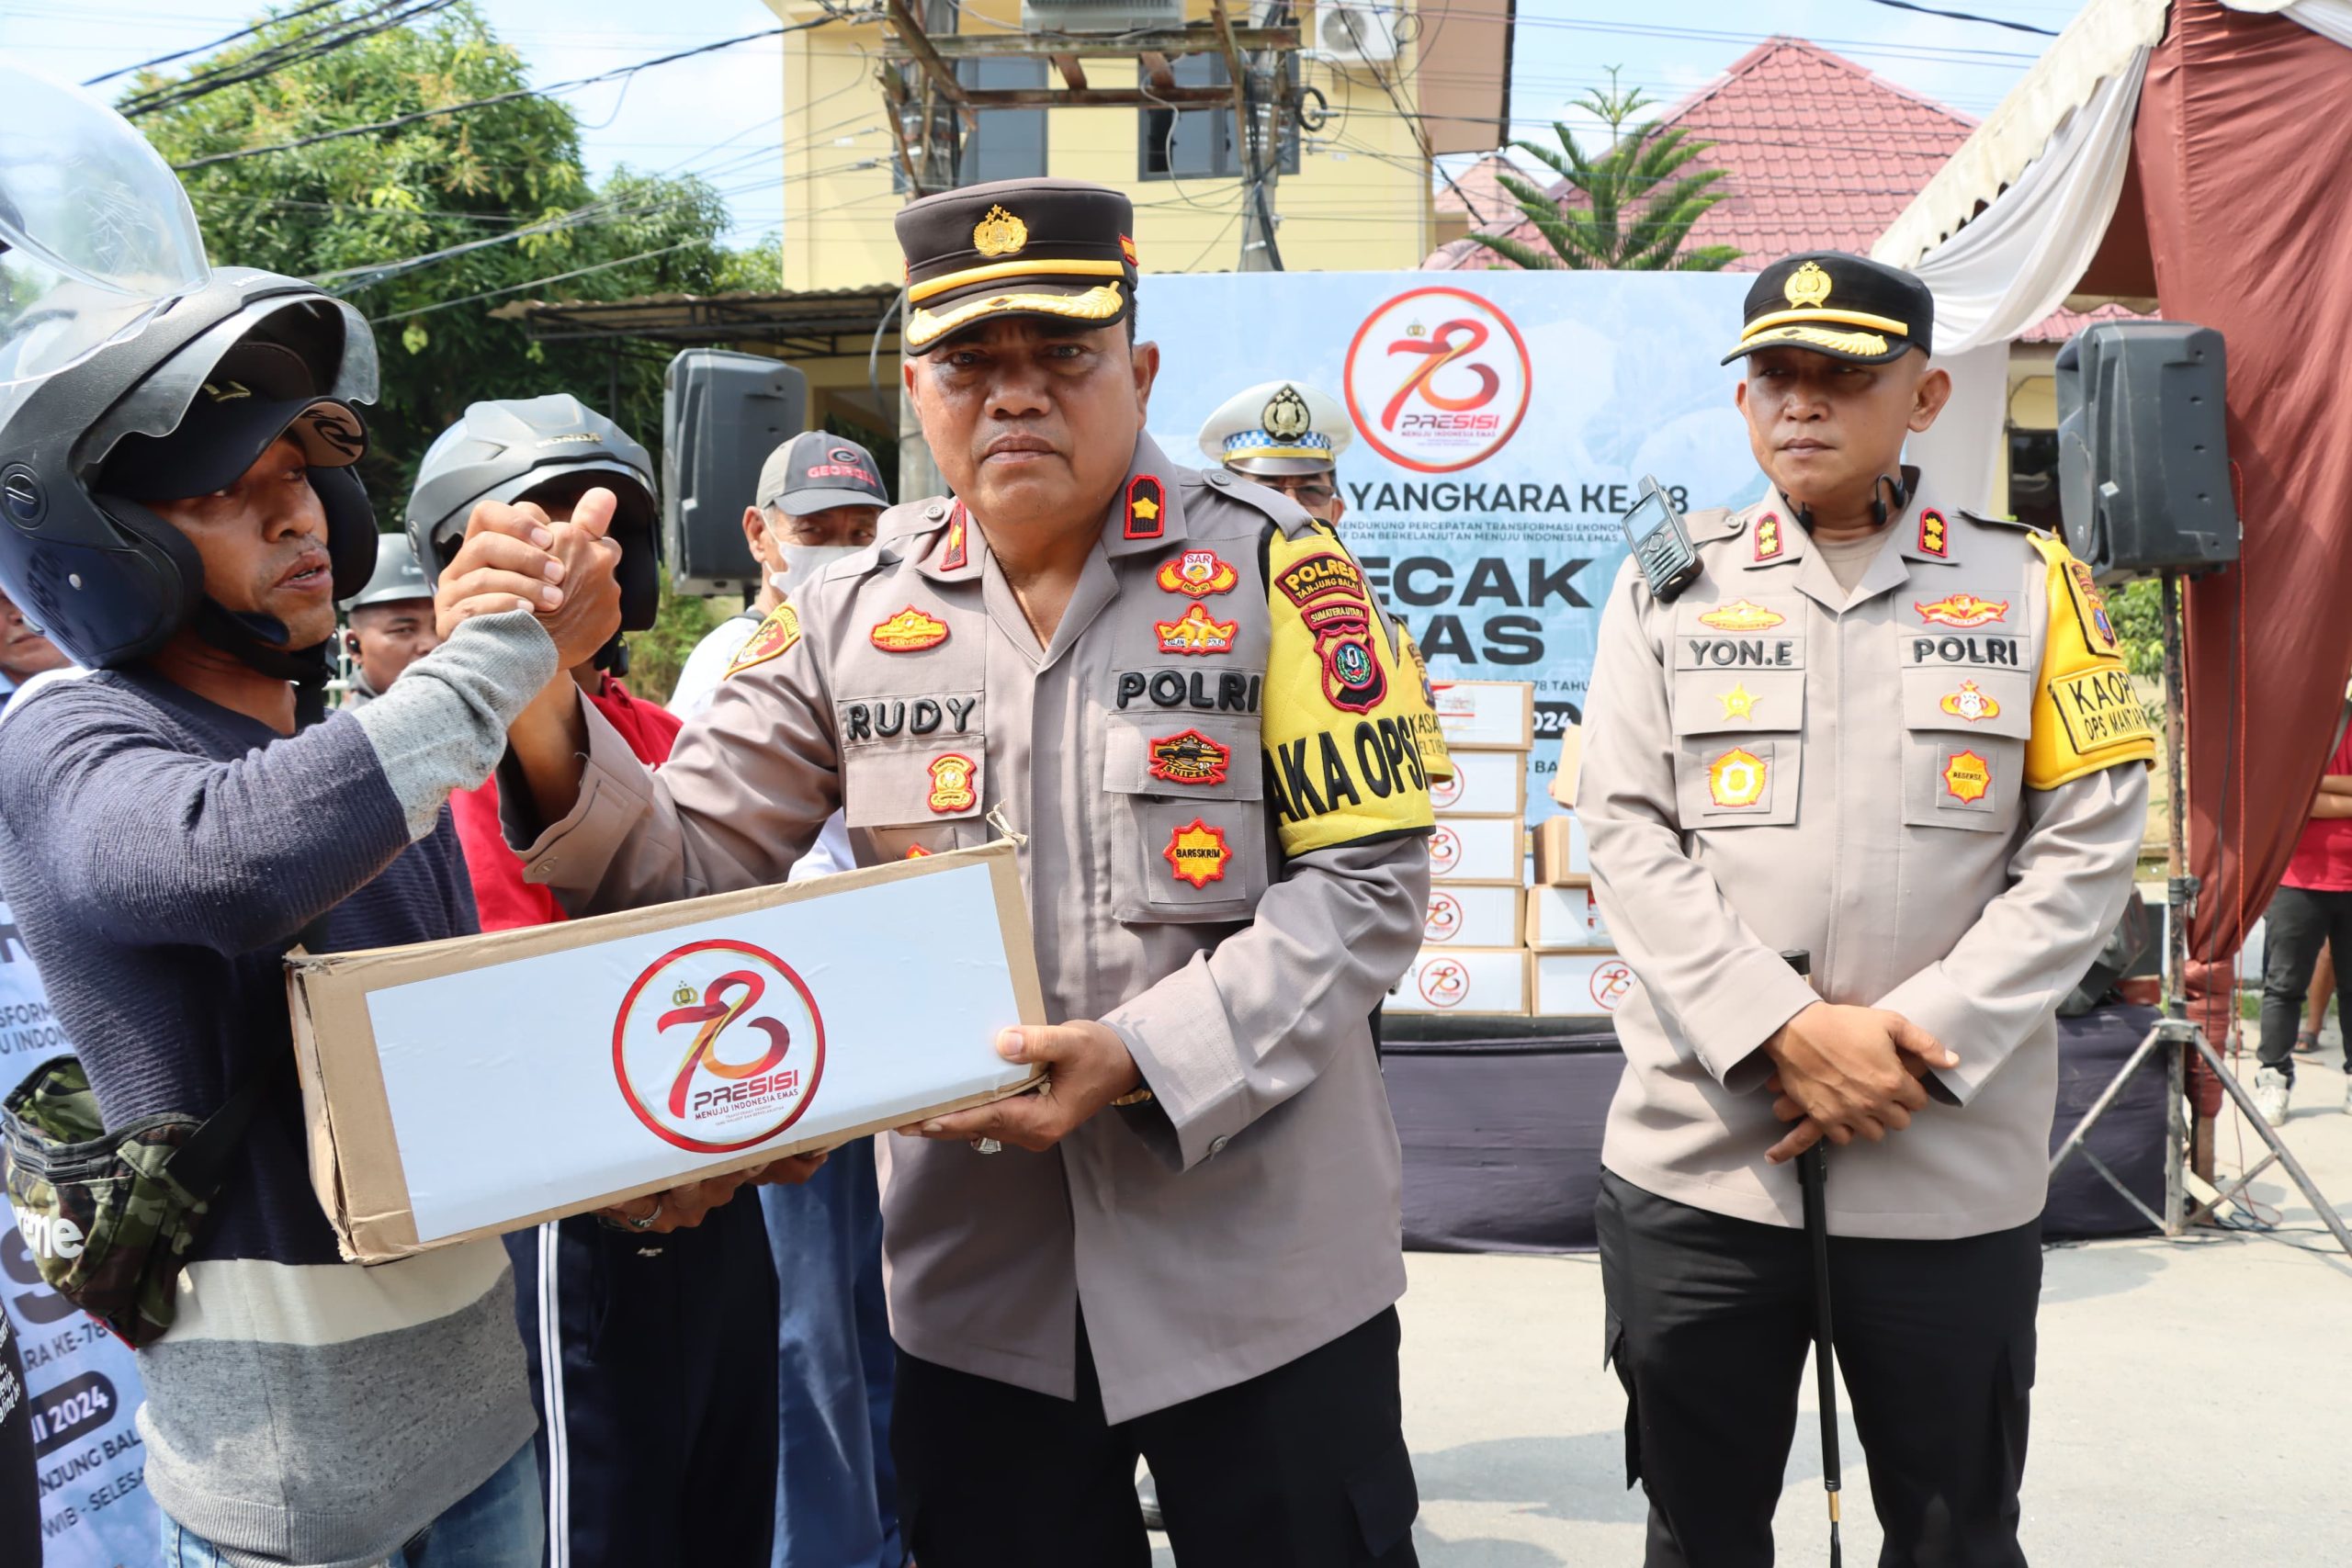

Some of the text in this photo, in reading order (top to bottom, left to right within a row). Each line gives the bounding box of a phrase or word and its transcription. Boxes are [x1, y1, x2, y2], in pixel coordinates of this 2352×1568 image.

[1401, 414, 1499, 429] PRESISI
[1581, 484, 1689, 515] KE-8
[1351, 532, 1375, 540] DAN
[1378, 532, 1471, 541] BERKELANJUTAN
[1475, 533, 1520, 541] MENUJU
[1523, 533, 1584, 542] INDONESIA
[1408, 522, 1482, 530] PERCEPATAN
[1486, 523, 1573, 531] TRANSFORMASI
[1186, 554, 1211, 564] SAR
[1284, 558, 1359, 592] POLRES
[1295, 577, 1338, 599] TANJUNG
[1402, 614, 1545, 665] AS
[1689, 639, 1793, 666] YON.E
[1914, 637, 2018, 666] POLRI
[1116, 670, 1260, 712] POLRI
[2068, 671, 2132, 715] KAOP
[846, 696, 977, 740] RUDY
[2085, 715, 2108, 740] OPS
[1165, 764, 1212, 778] SNIPER
[694, 1069, 798, 1111] PRESISI
[695, 1089, 798, 1122] MENUJU INDONESIA EMAS
[48, 1385, 109, 1434] 2024
